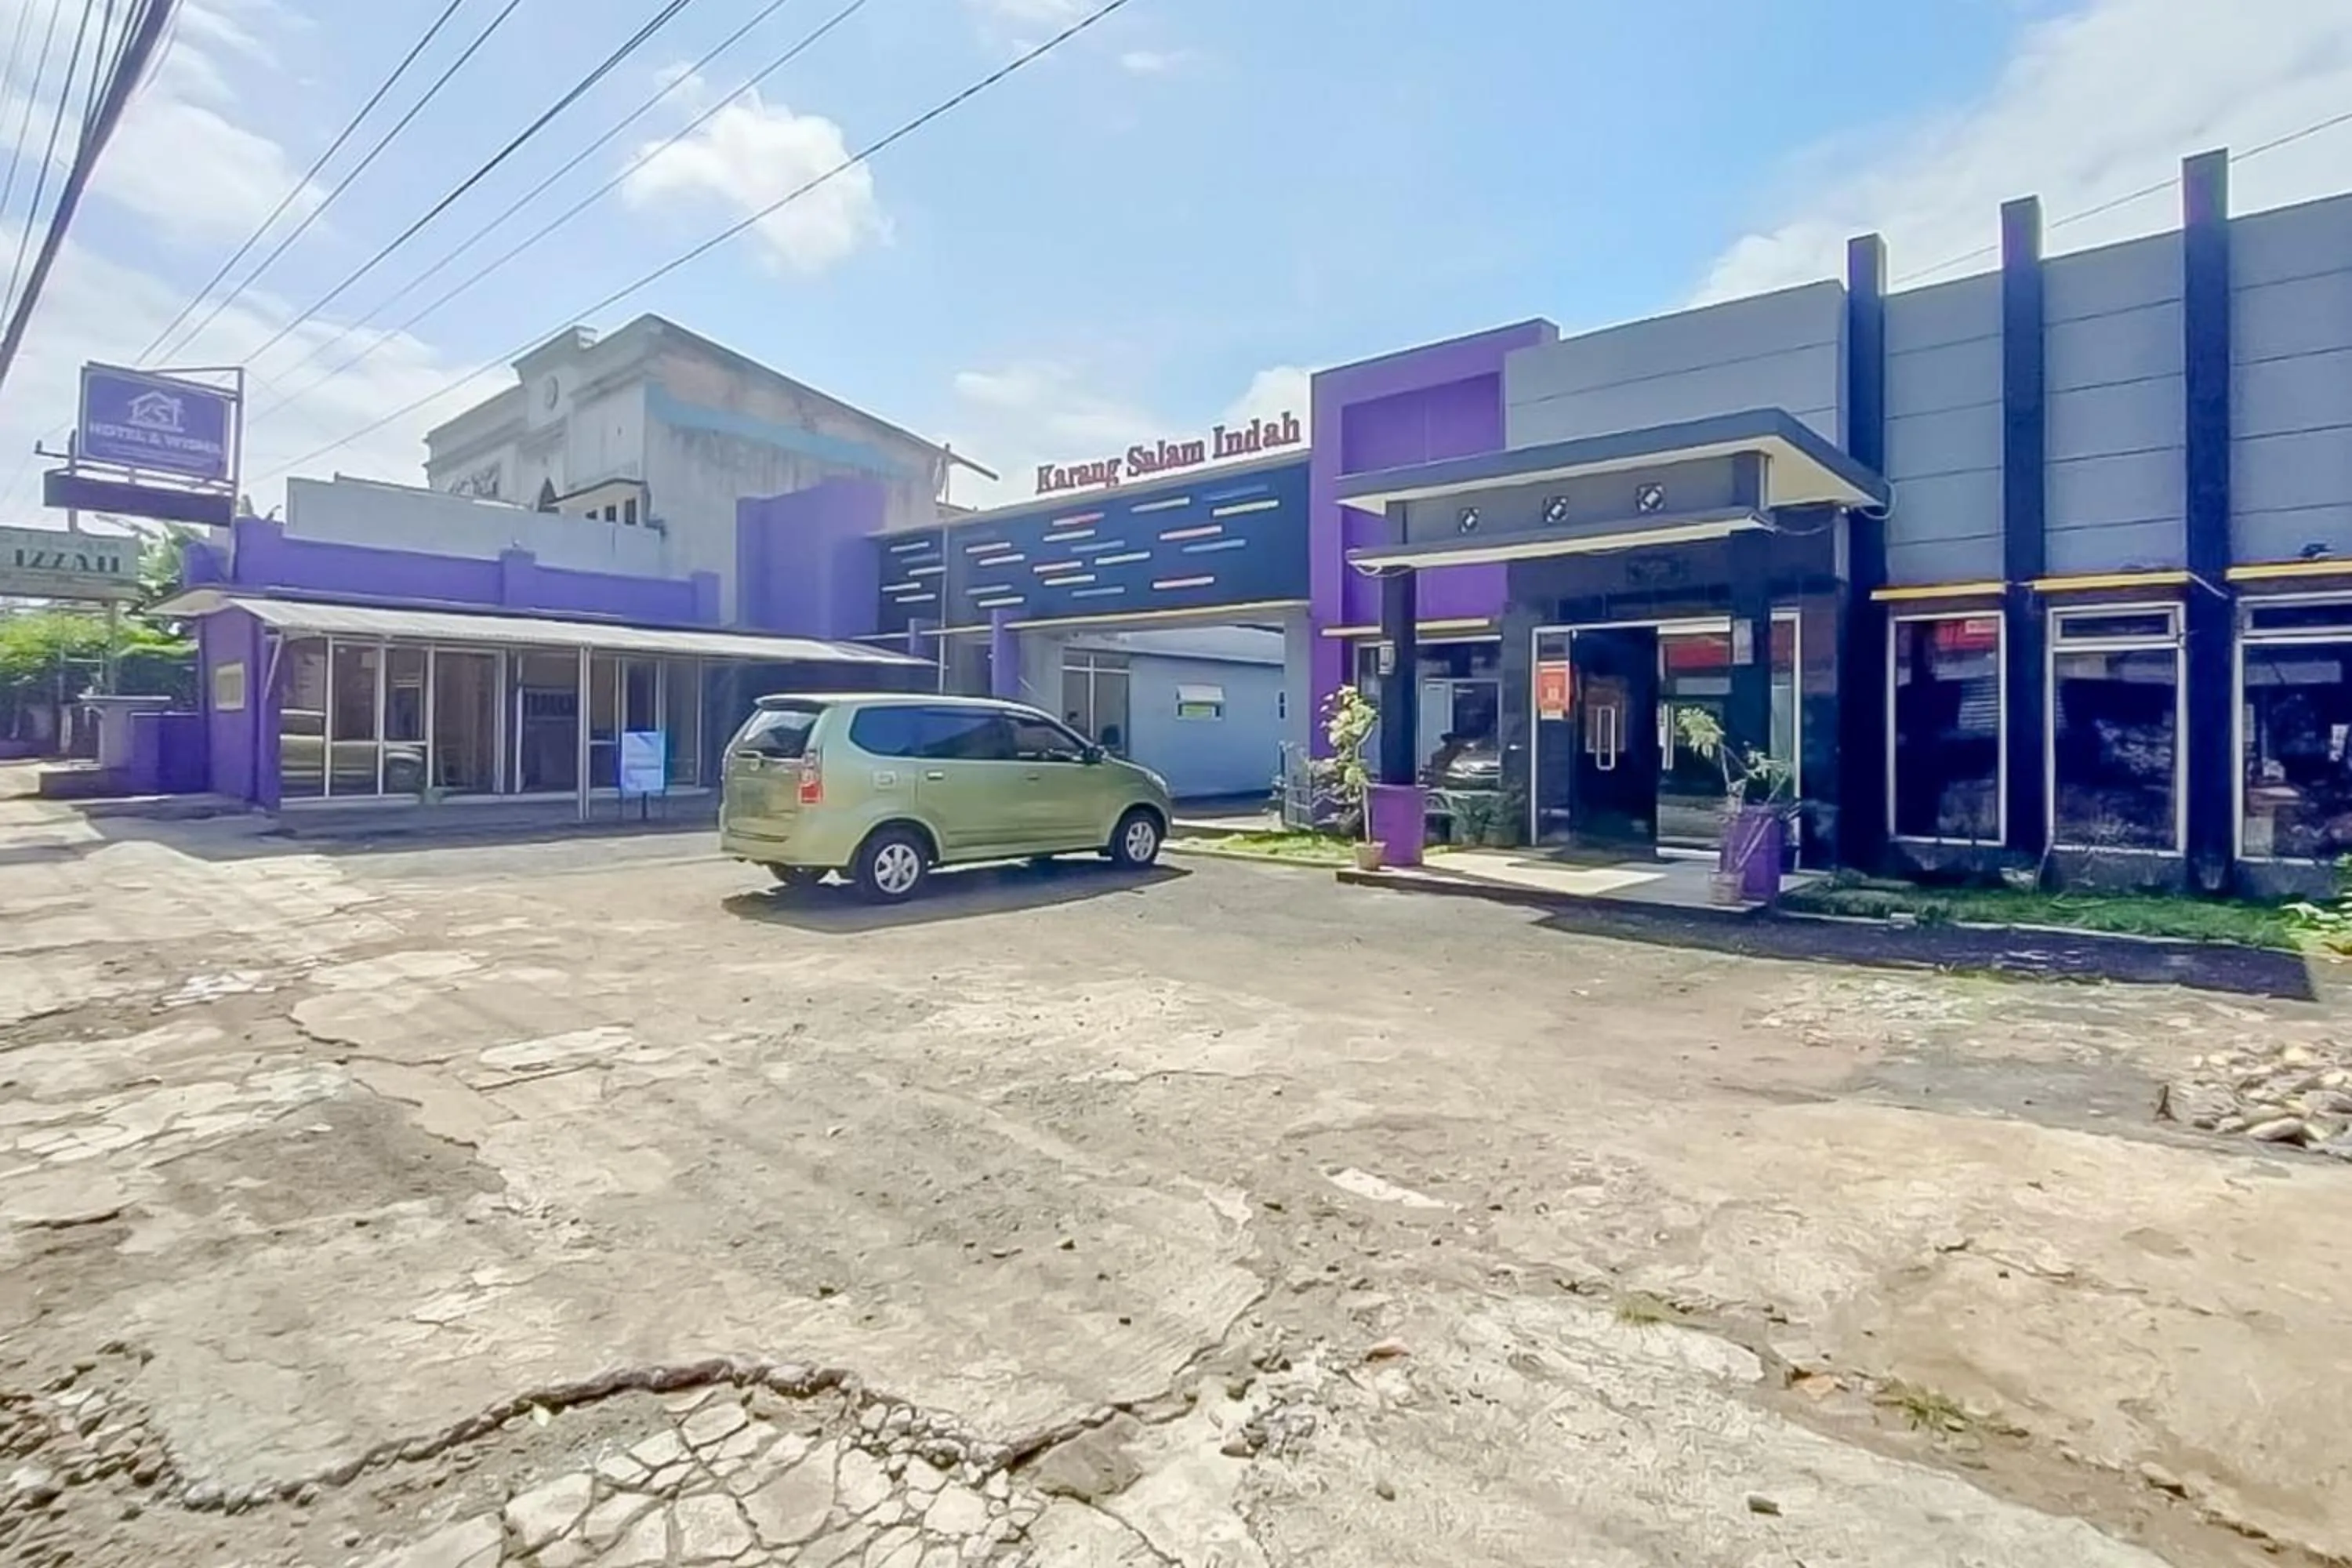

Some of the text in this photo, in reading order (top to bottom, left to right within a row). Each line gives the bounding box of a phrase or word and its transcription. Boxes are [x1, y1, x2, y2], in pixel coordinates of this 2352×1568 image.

[89, 421, 145, 444] HOTEL
[1036, 411, 1301, 495] Karang Salam Indah
[14, 547, 120, 573] IZZAH
